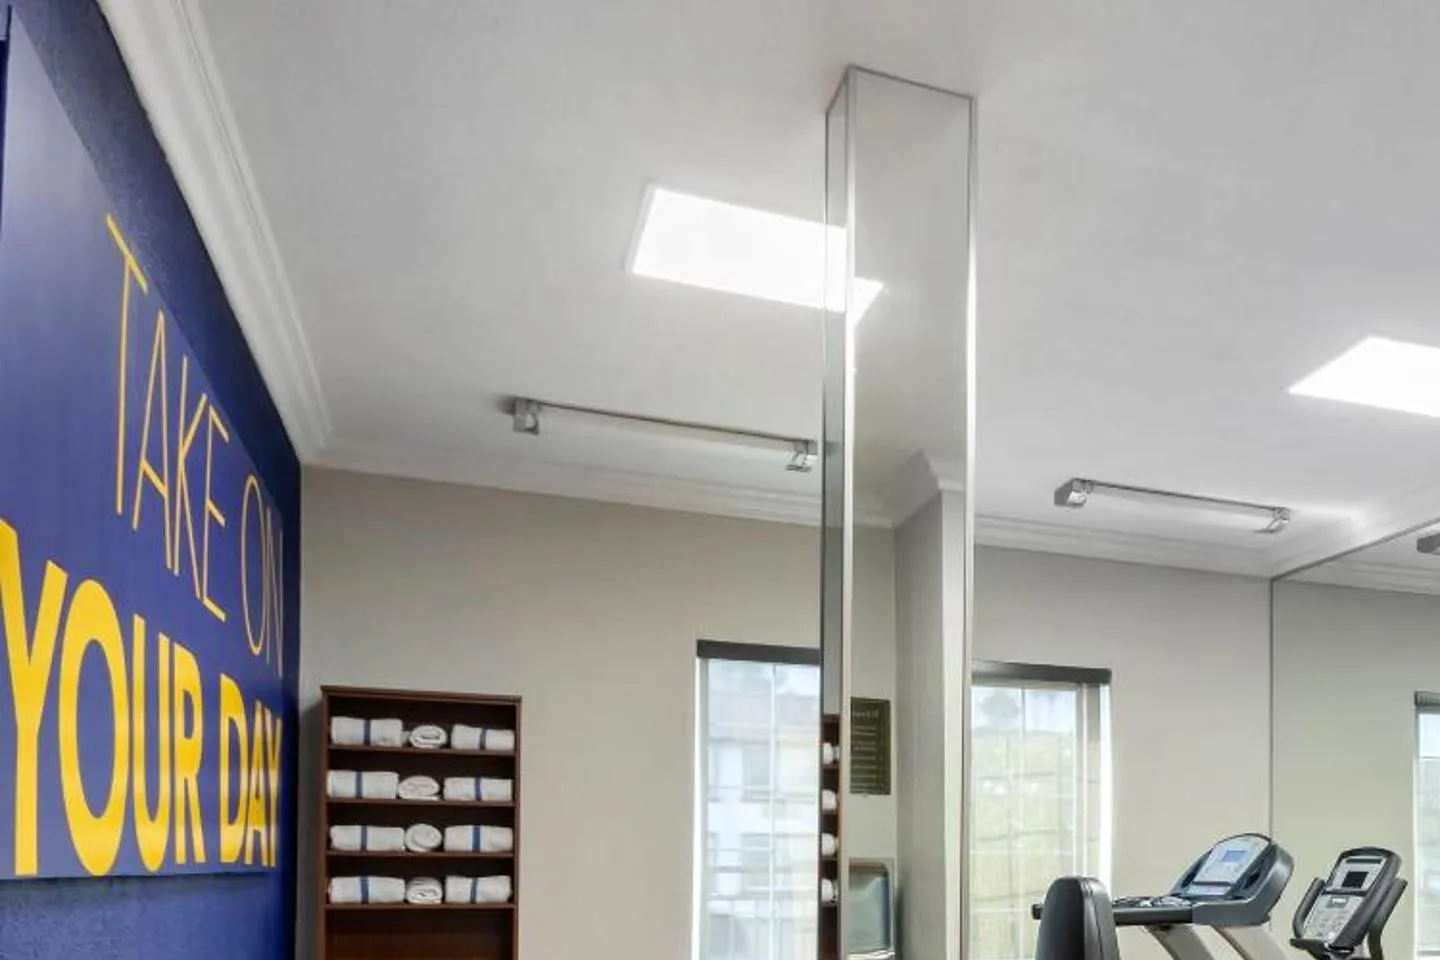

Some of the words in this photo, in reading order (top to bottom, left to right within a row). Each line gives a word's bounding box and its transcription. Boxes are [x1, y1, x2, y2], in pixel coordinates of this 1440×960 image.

[106, 213, 230, 622] TAKE
[241, 474, 284, 678] ON
[0, 518, 206, 877] YOUR
[220, 673, 283, 867] DAY
